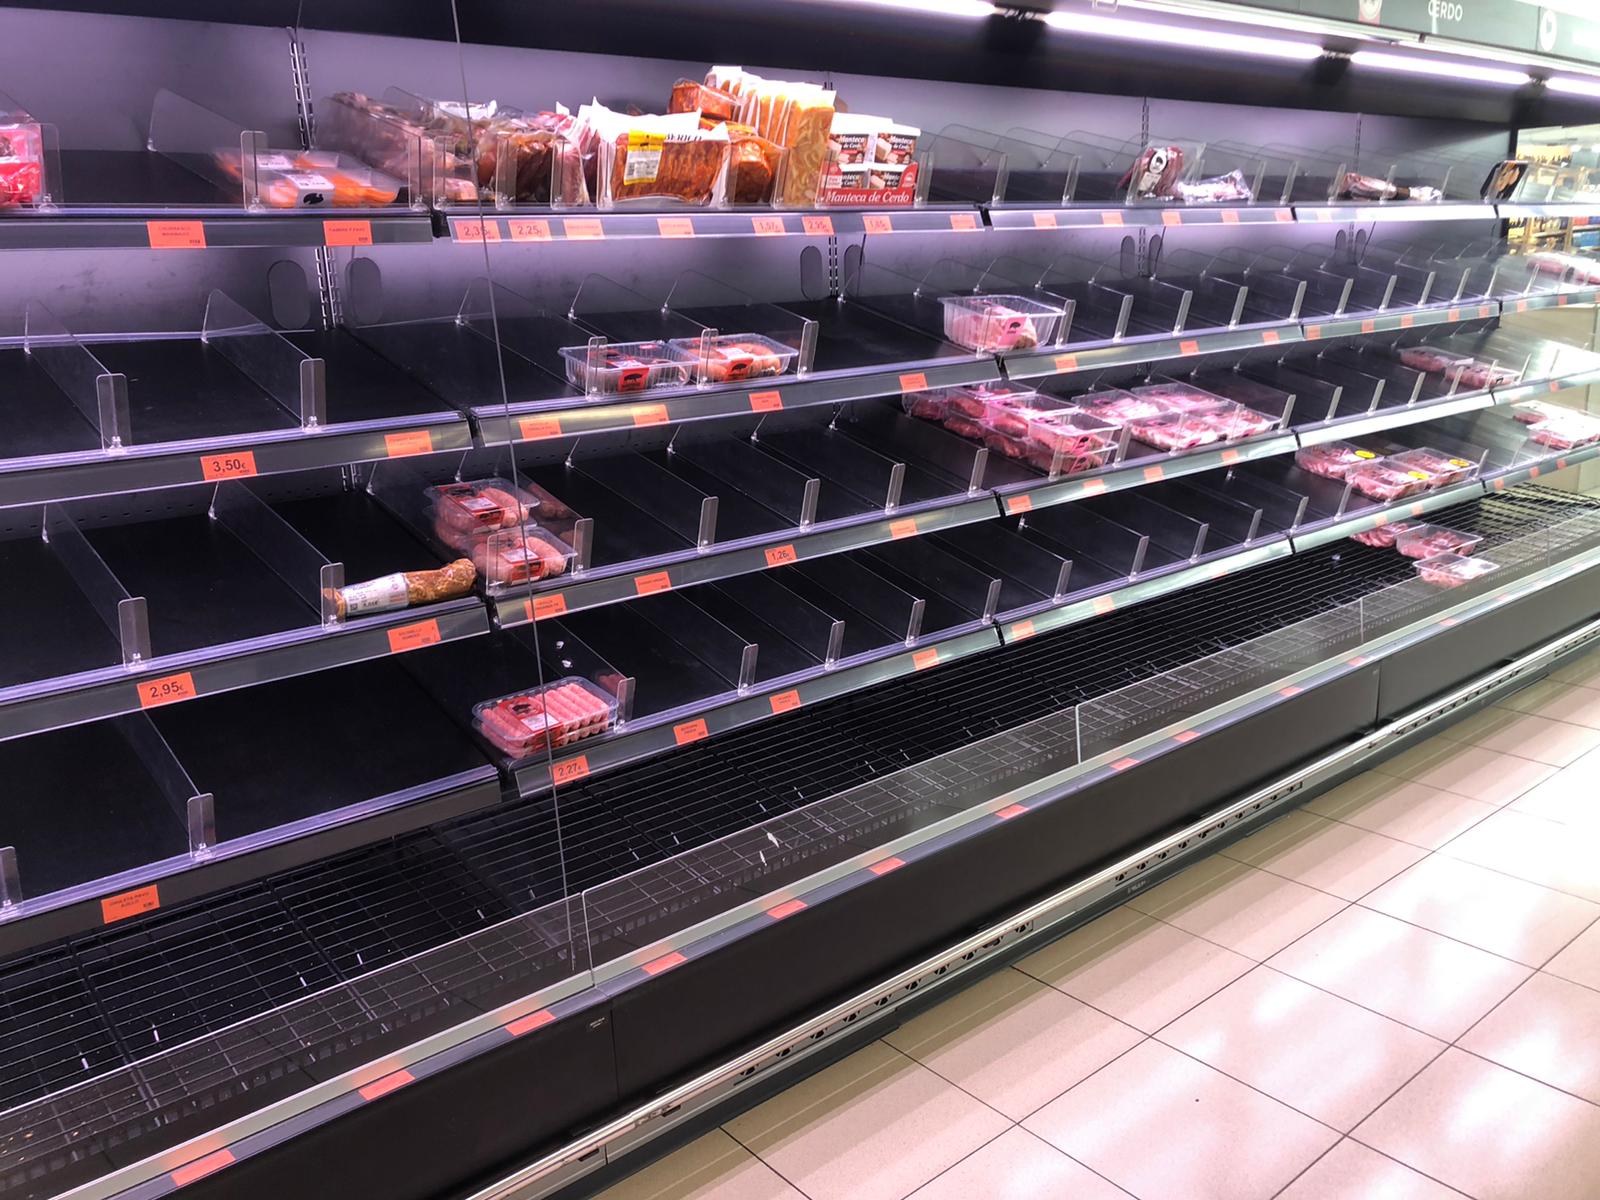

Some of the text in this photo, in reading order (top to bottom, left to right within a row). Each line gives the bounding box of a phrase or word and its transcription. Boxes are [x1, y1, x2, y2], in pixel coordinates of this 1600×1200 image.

[1428, 0, 1463, 21] CERDO
[826, 190, 910, 203] Manteca de Cerdo
